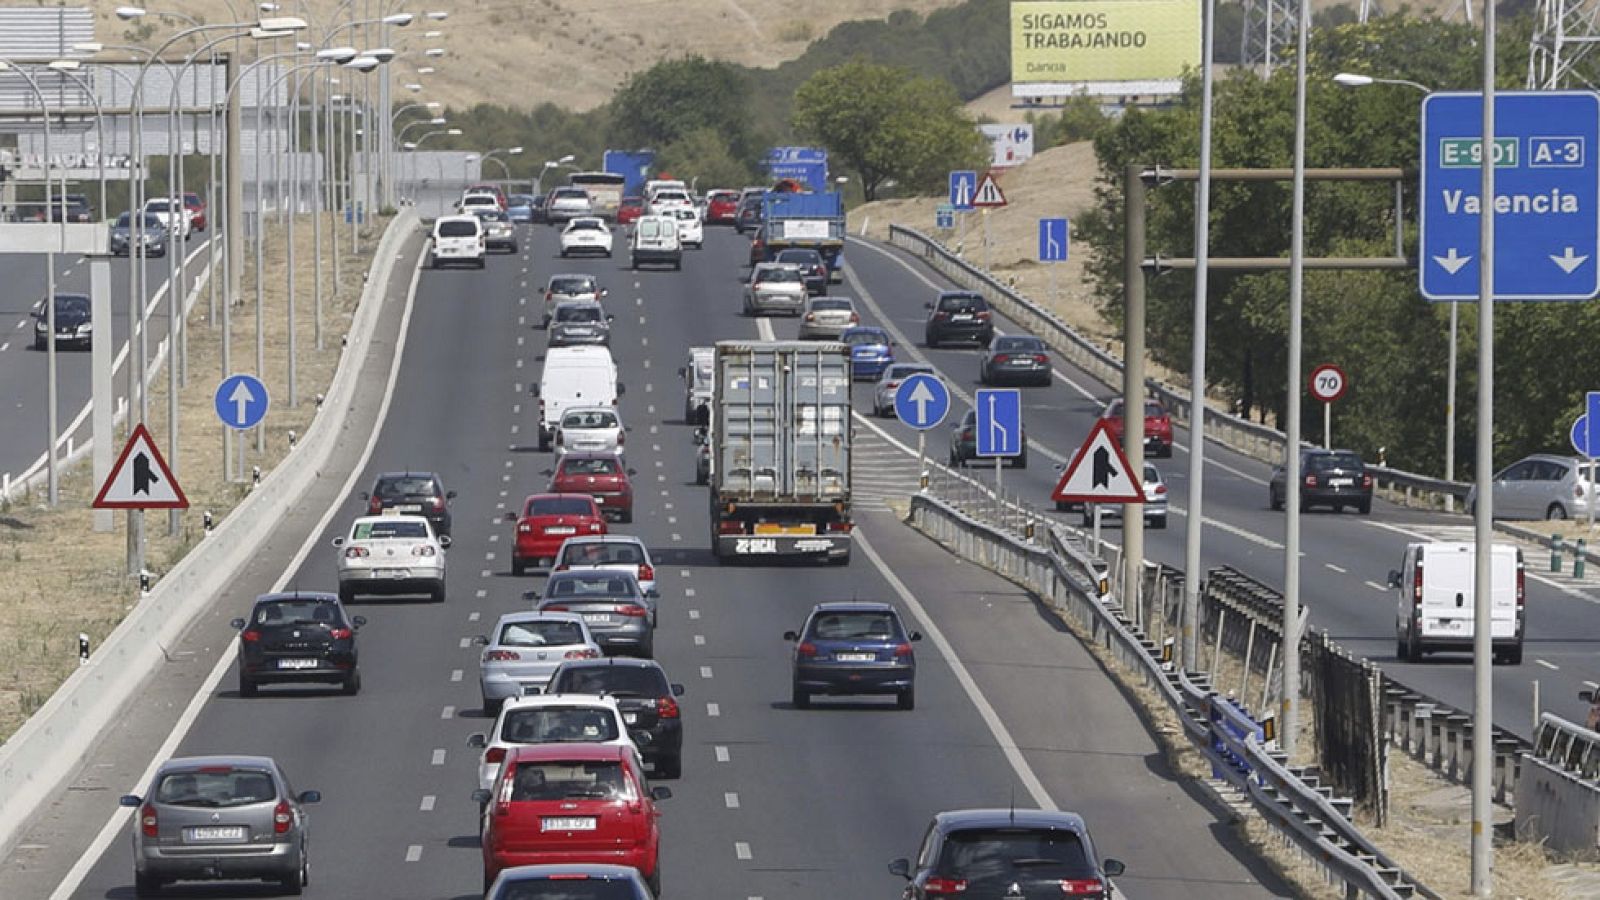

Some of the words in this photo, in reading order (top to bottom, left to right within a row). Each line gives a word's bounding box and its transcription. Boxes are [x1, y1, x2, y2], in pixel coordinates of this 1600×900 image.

[1022, 13, 1108, 30] SIGAMOS
[1022, 31, 1147, 49] TRABAJANDO
[1534, 142, 1580, 163] A-3
[1442, 187, 1578, 214] Vaencia
[1318, 376, 1338, 390] 70
